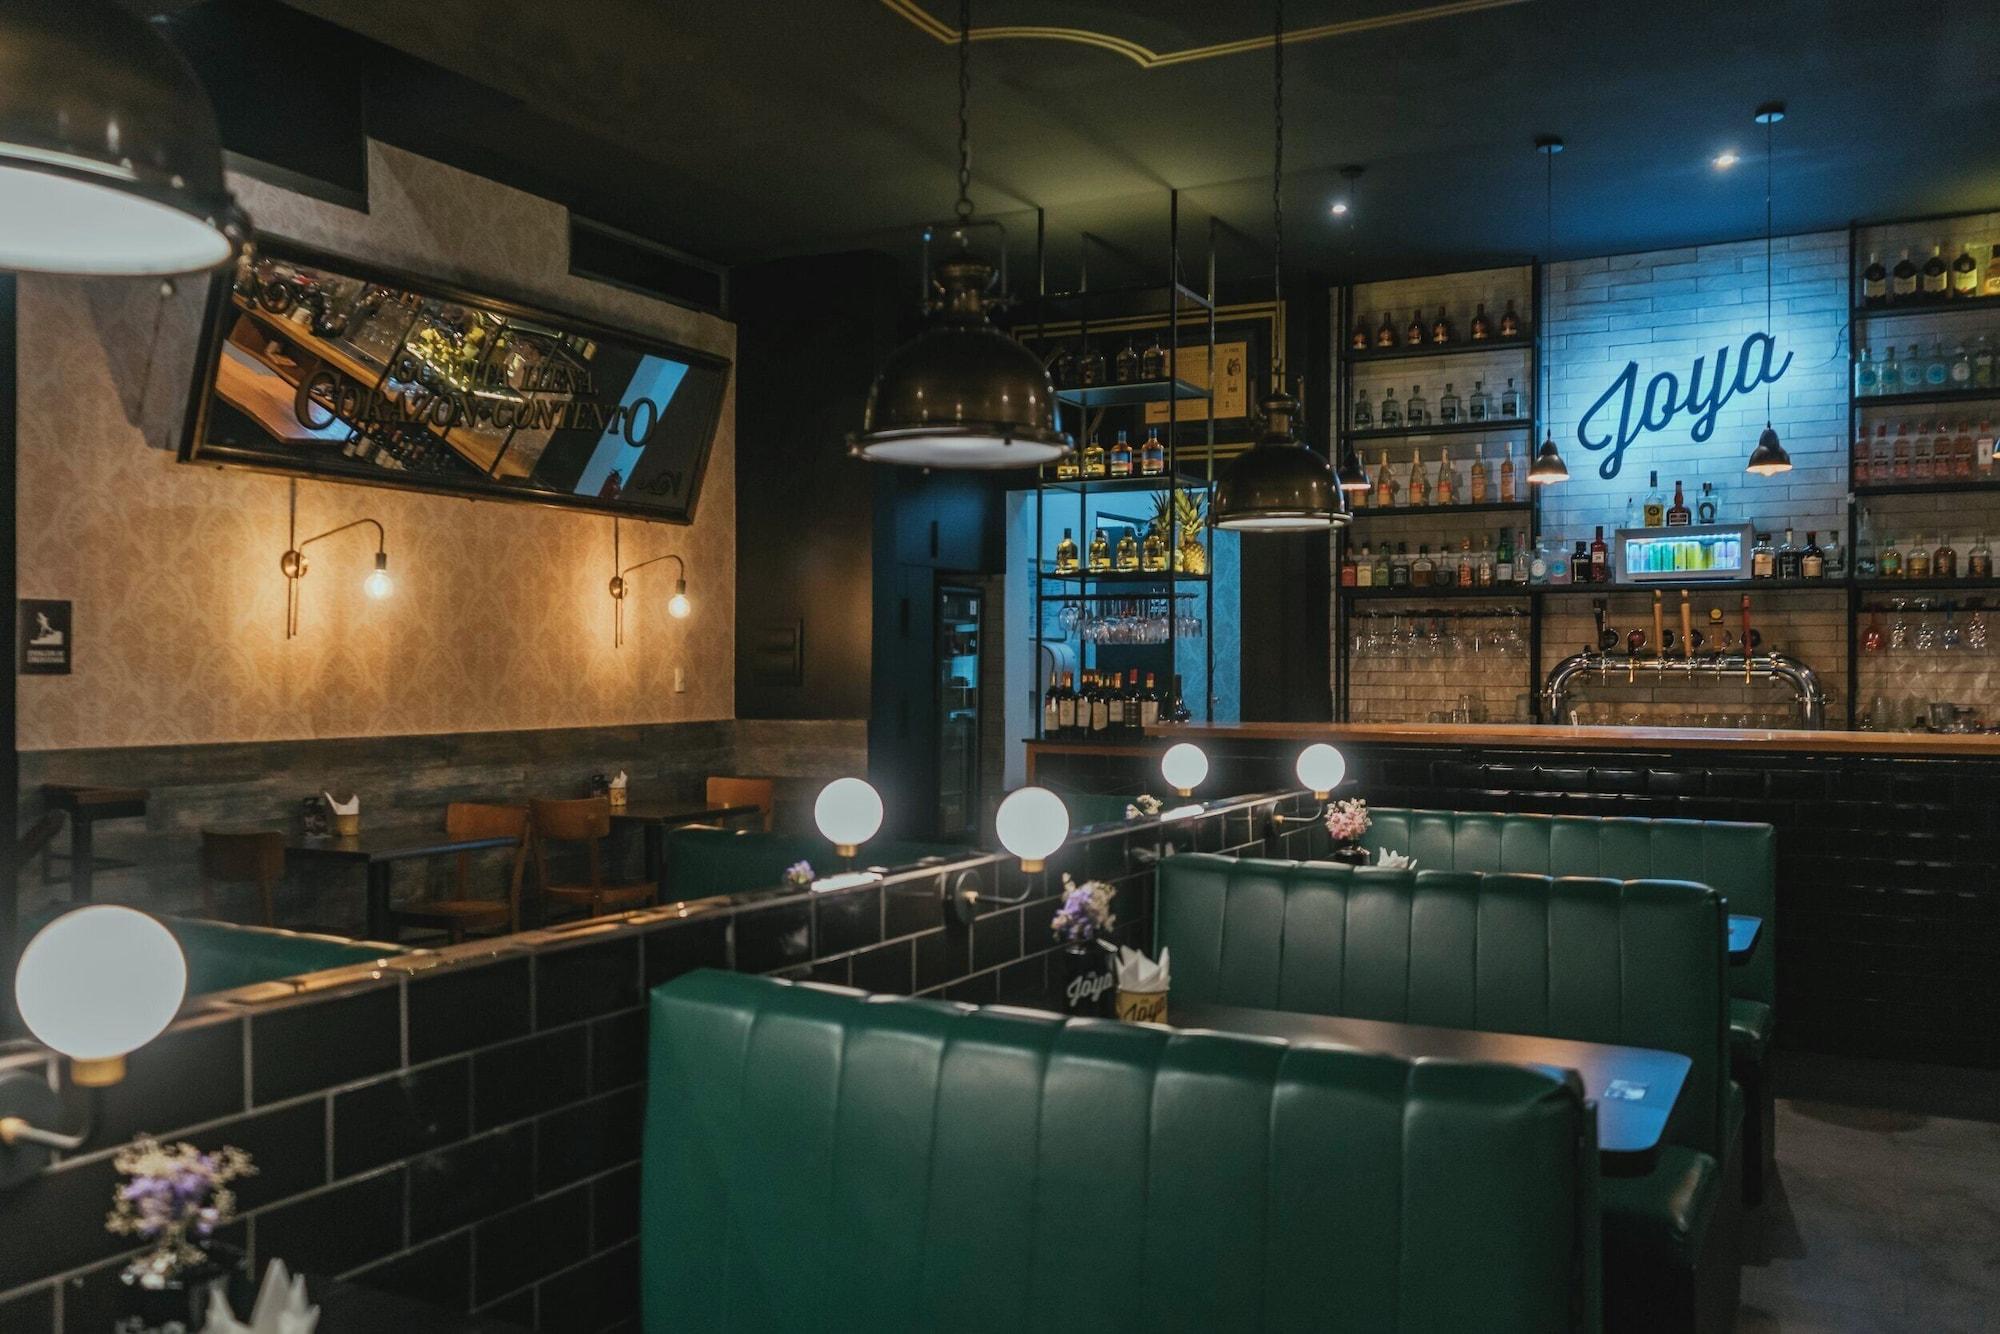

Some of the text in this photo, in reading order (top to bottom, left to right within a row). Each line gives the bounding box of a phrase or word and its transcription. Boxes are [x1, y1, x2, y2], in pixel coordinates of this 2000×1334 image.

[493, 397, 658, 447] CONTENTO
[1577, 332, 1794, 480] Joya
[1067, 975, 1113, 1007] Joya
